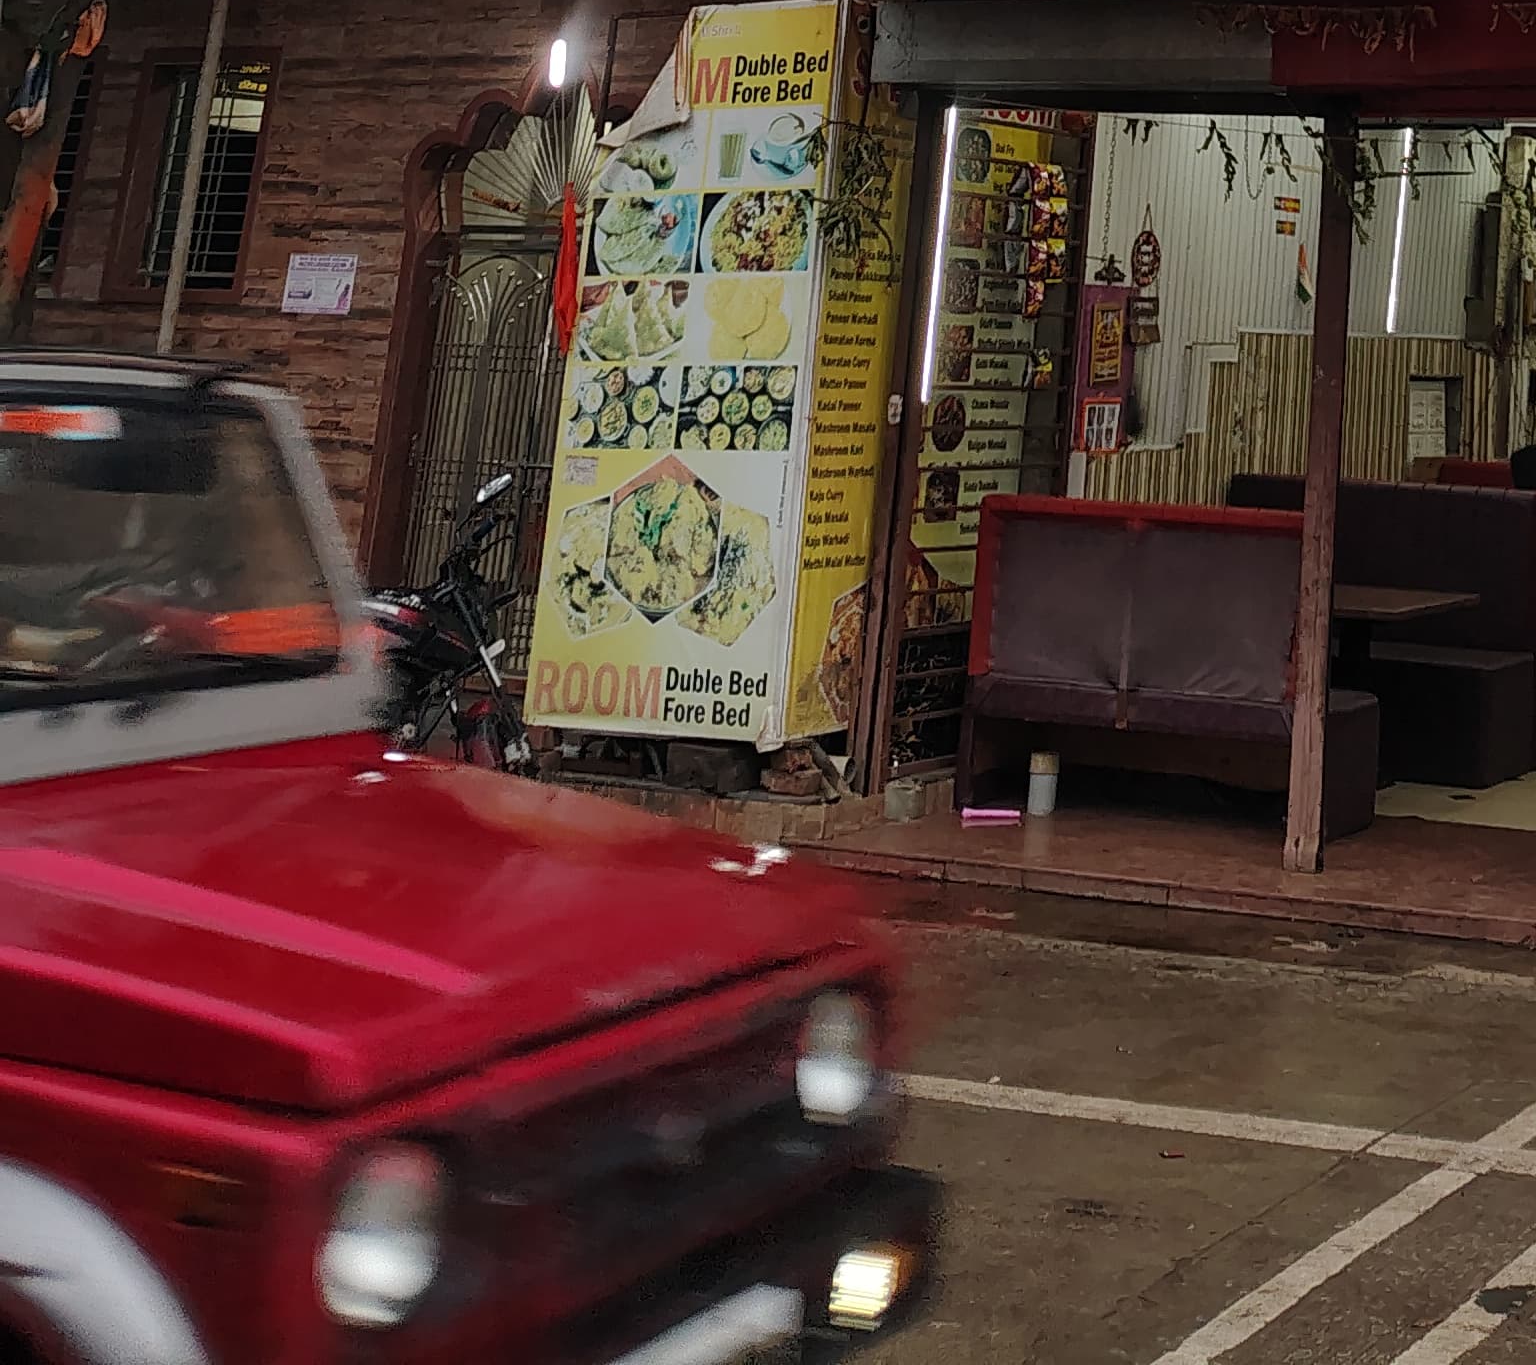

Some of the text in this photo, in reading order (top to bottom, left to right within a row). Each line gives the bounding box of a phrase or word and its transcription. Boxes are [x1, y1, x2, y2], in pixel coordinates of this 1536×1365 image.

[735, 54, 787, 77] Duble
[793, 50, 829, 73] Bed
[732, 78, 813, 104] Fore Bed
[533, 661, 768, 719] ROOM Duble Bed
[663, 697, 750, 727] Fore Bed
